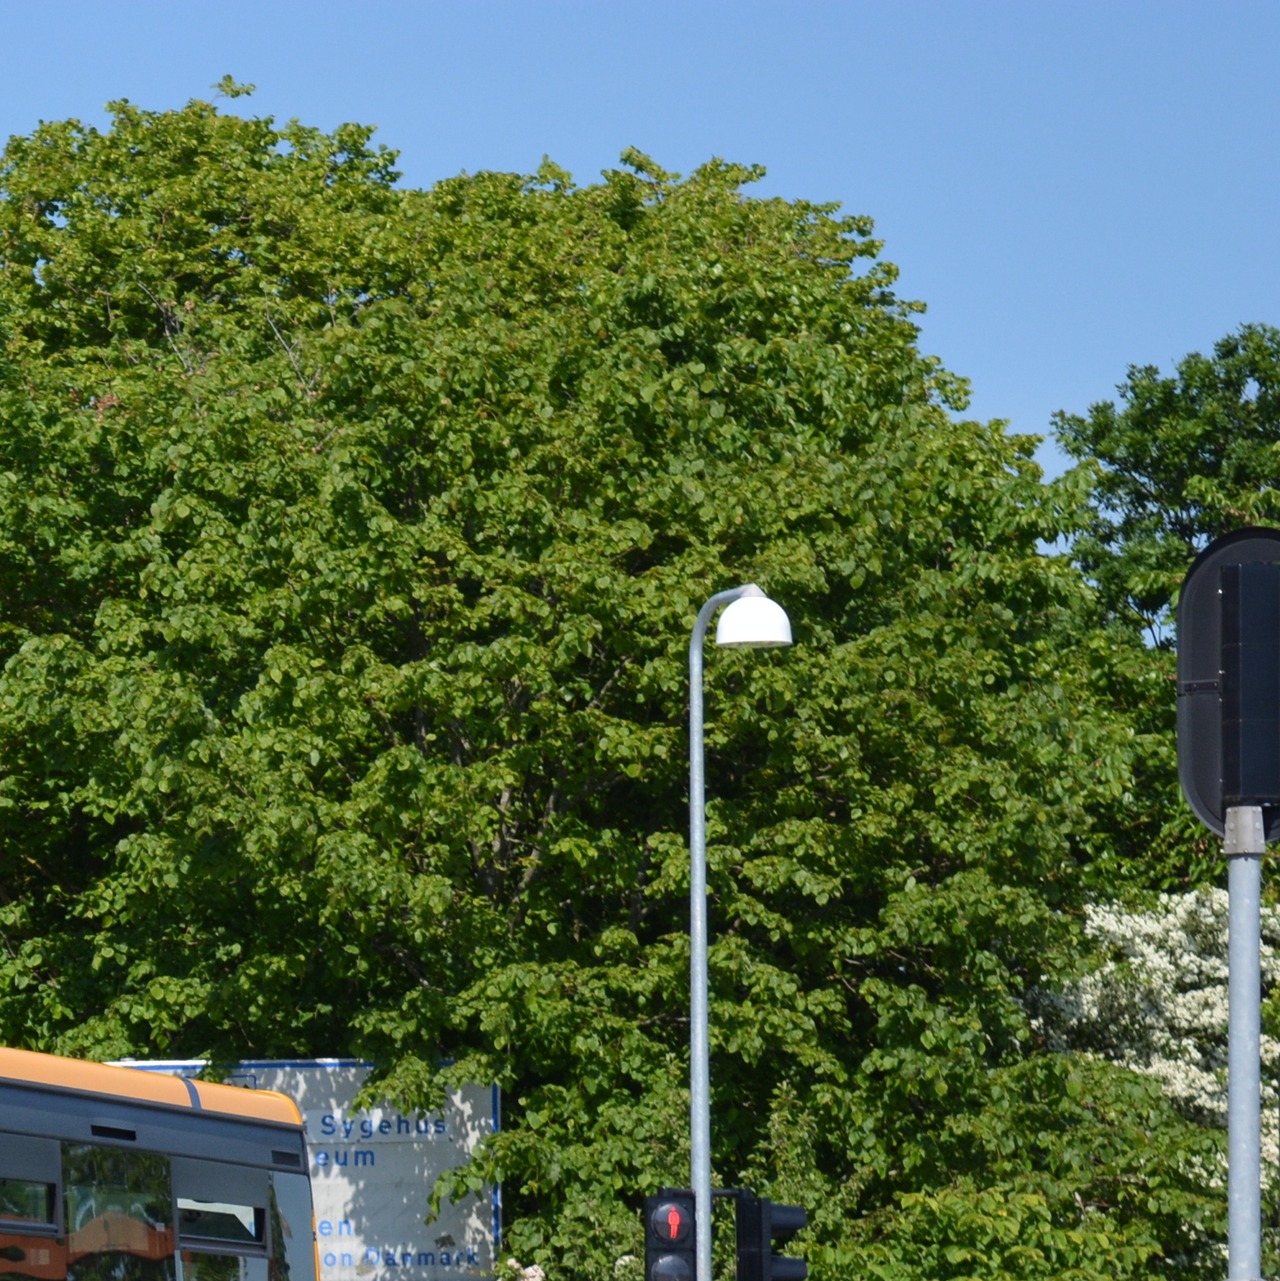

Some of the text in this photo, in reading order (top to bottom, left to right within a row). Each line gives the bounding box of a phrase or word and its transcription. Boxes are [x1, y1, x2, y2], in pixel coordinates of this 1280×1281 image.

[320, 1114, 447, 1139] Sygehus
[315, 1149, 376, 1167] eum
[318, 1219, 353, 1236] en
[323, 1247, 480, 1268] on Danmark
